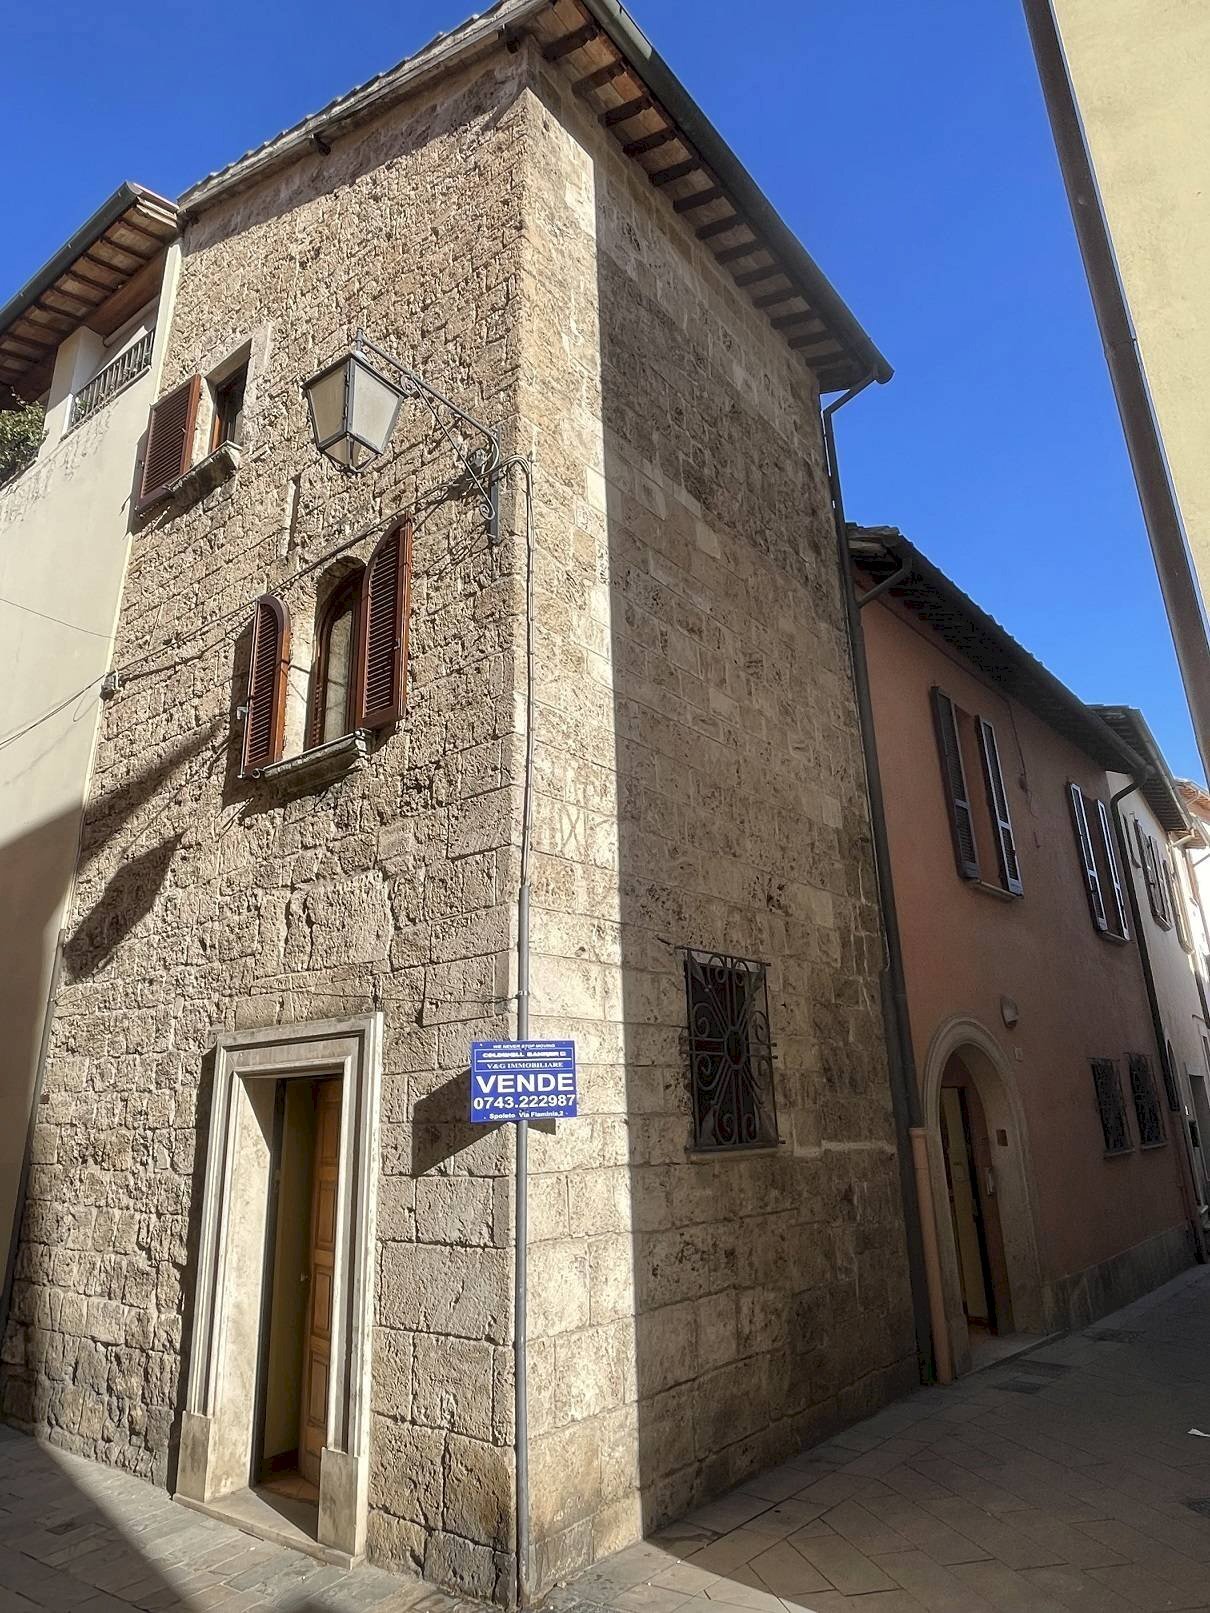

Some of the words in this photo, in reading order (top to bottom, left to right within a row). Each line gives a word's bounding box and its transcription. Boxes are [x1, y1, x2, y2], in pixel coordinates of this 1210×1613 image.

[475, 1073, 574, 1094] VENDE
[473, 1094, 576, 1110] 0743.222987
[489, 1112, 516, 1120] Spoleto
[519, 1110, 530, 1118] Via
